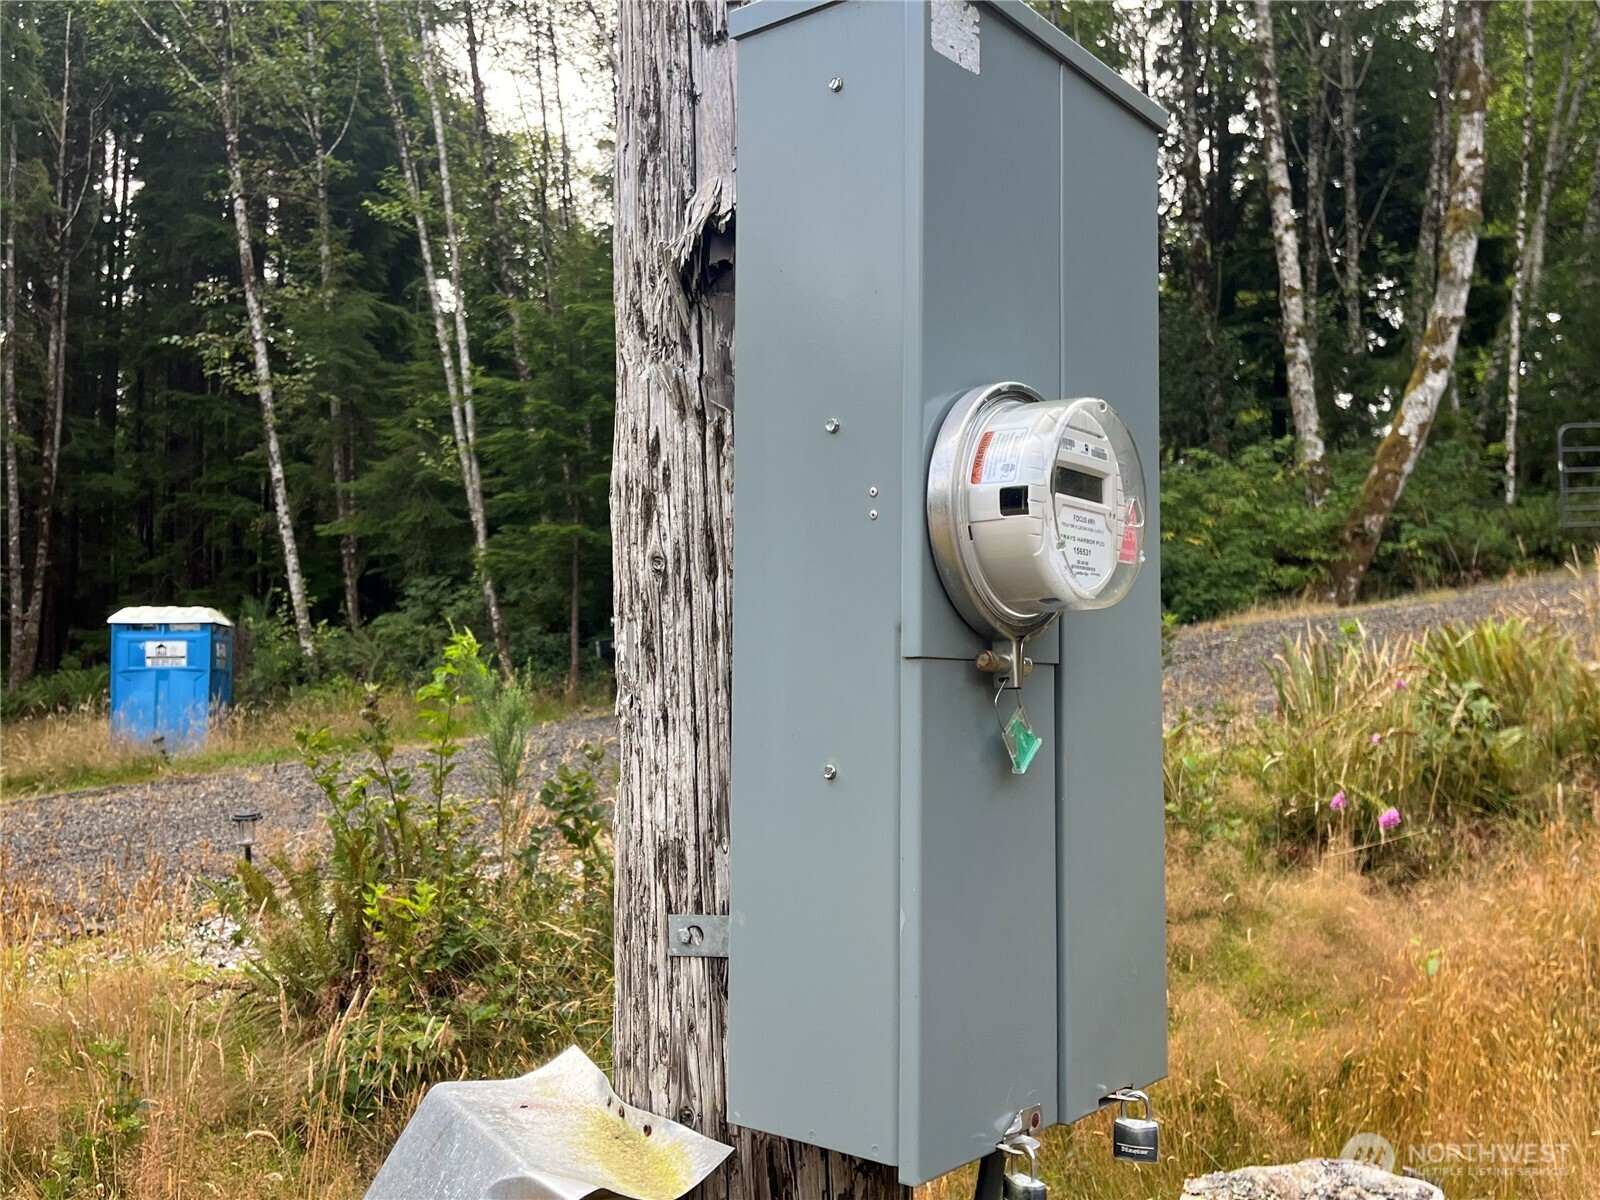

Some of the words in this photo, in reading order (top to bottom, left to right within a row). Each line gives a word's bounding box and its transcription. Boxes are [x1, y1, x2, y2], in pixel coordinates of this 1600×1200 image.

[975, 431, 994, 468] WARNING
[1073, 514, 1088, 524] FOCUS
[1076, 536, 1096, 545] HARBOR
